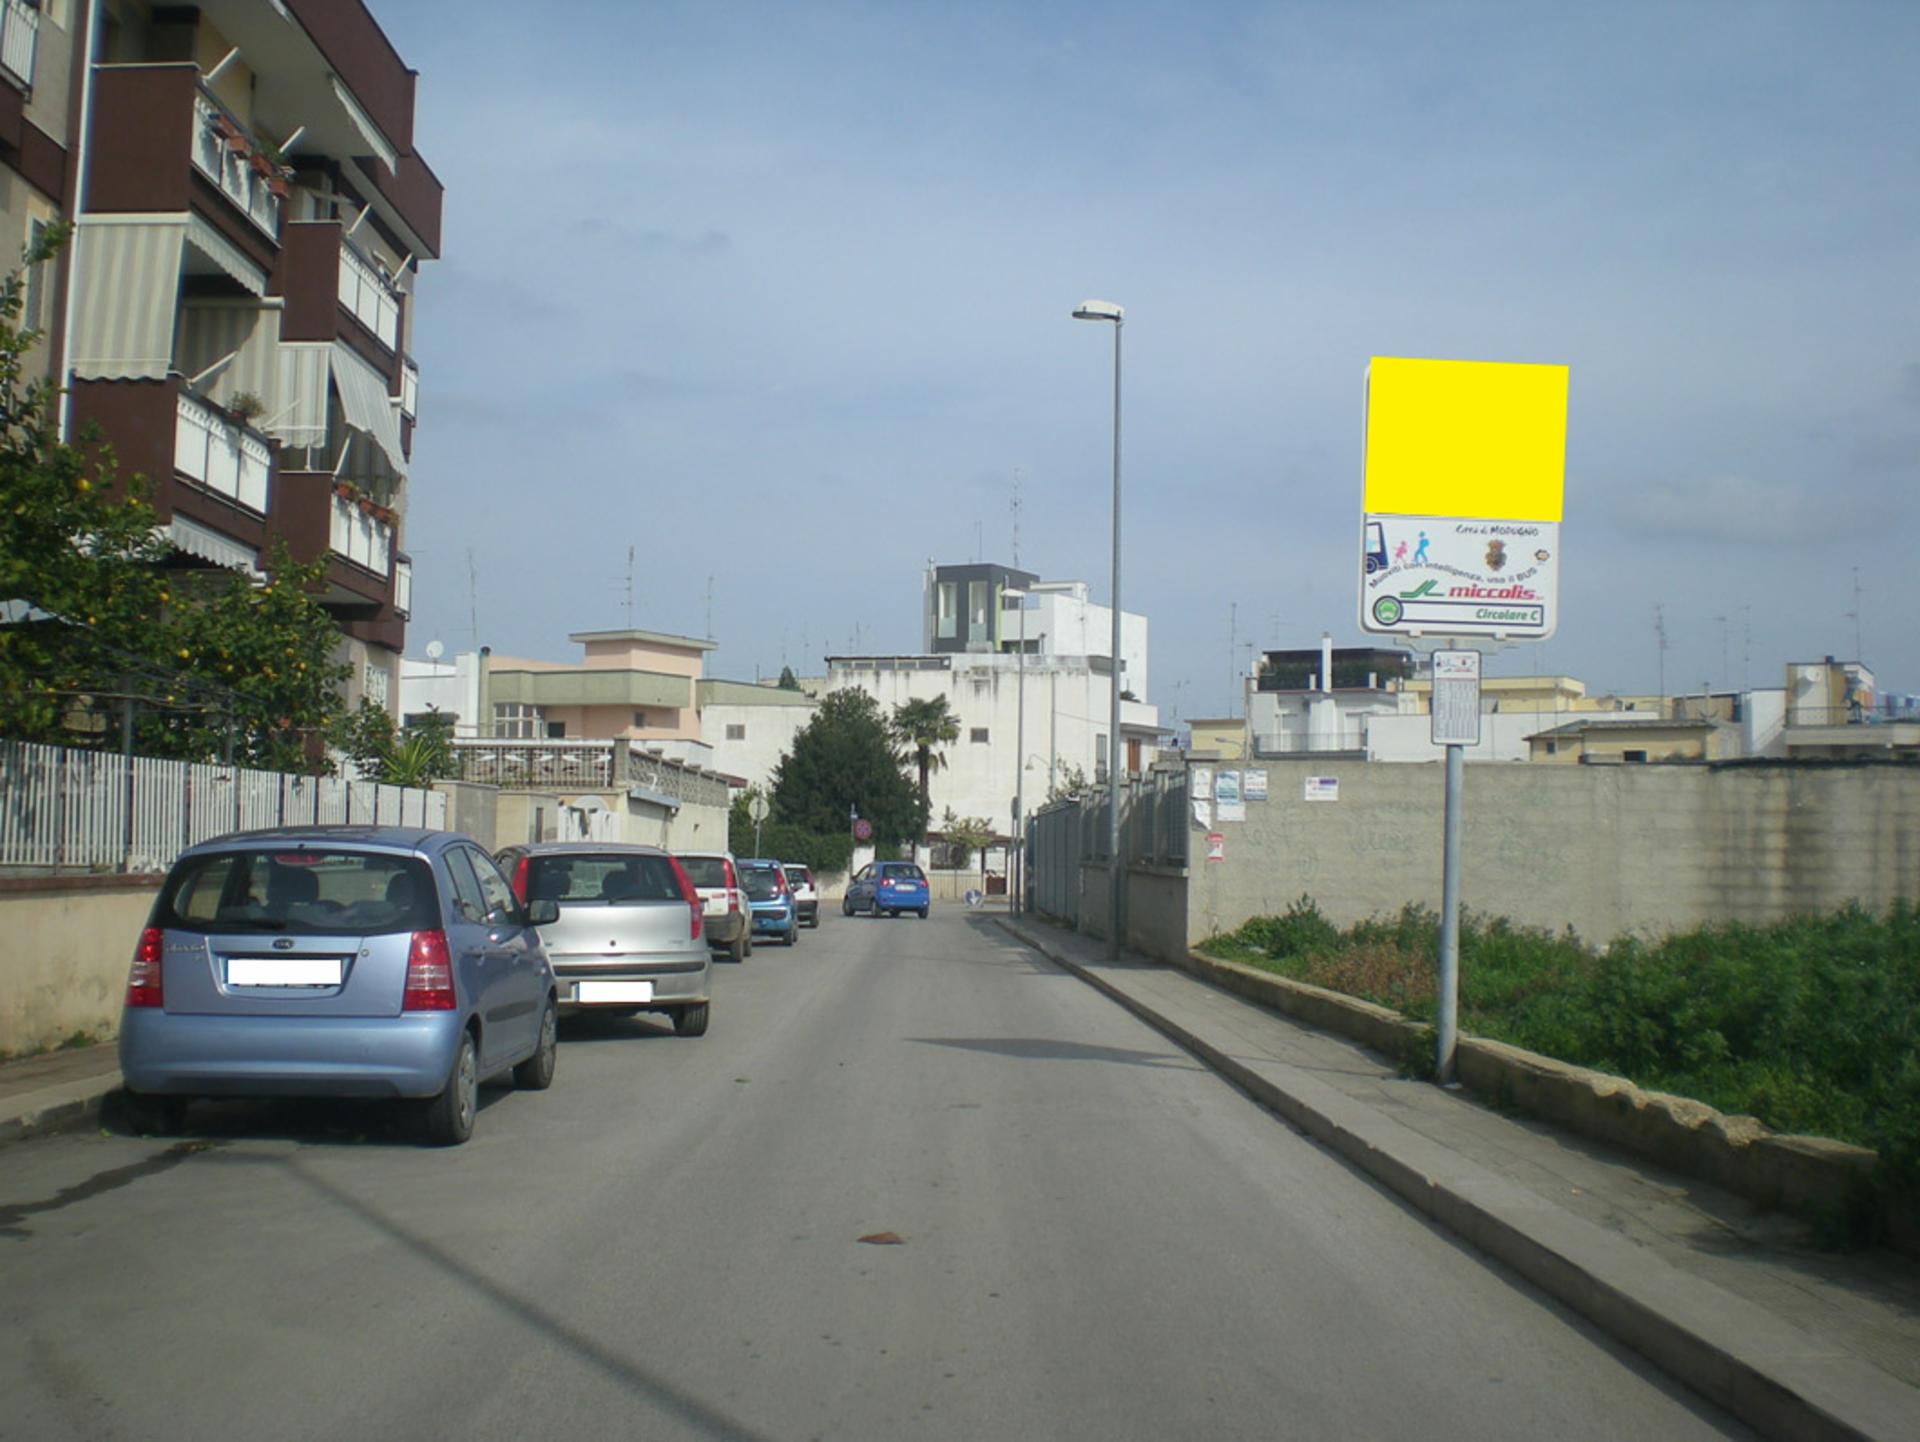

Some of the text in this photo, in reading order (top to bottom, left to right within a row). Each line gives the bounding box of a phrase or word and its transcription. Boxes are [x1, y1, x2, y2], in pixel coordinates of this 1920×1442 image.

[1516, 567, 1538, 582] BUS
[1448, 583, 1536, 600] miccolis
[1476, 608, 1539, 621] Circolare C
